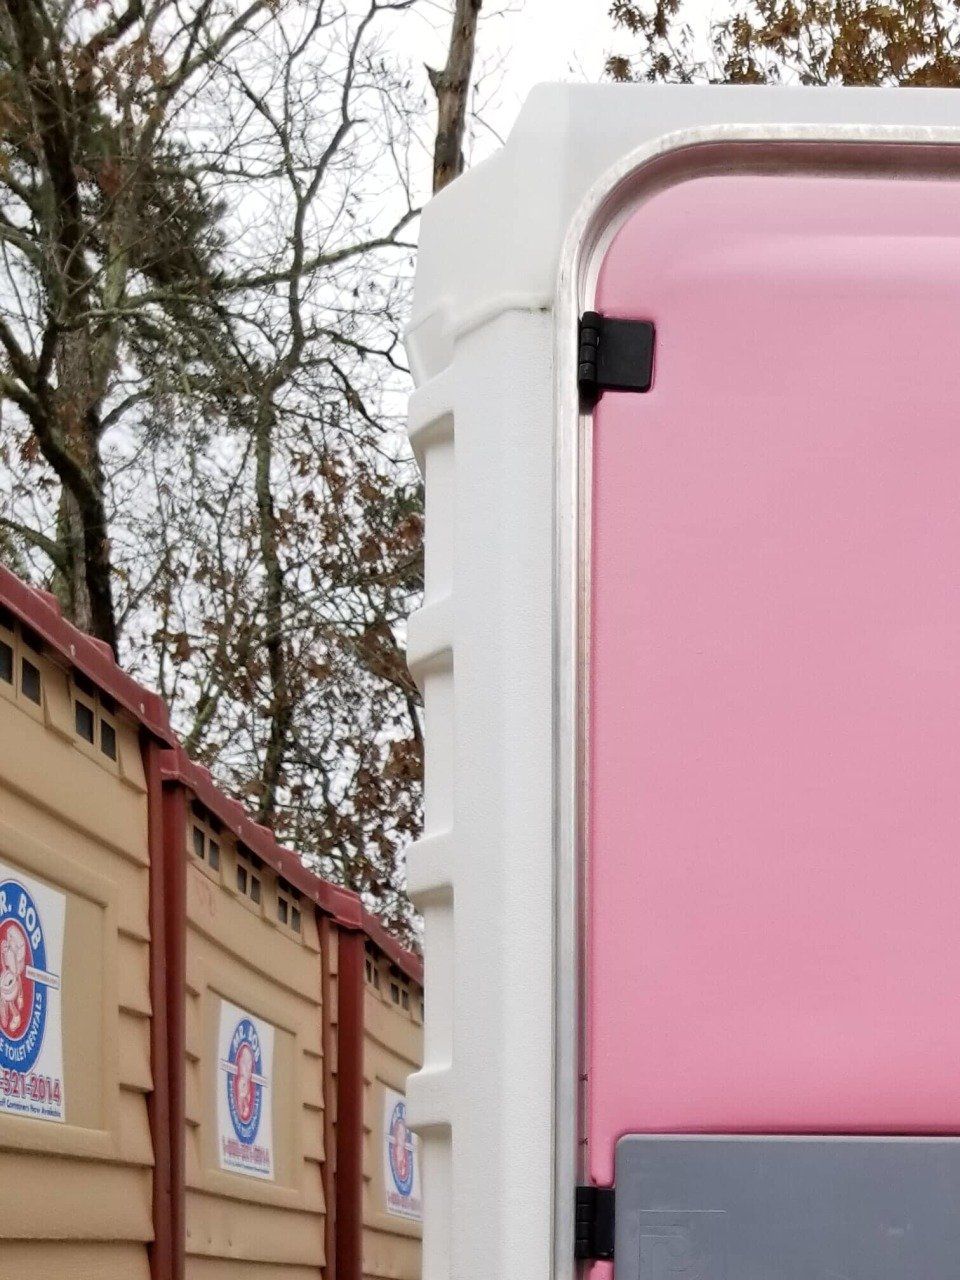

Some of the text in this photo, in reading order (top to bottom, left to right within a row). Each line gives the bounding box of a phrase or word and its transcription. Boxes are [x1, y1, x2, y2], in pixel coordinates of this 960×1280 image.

[18, 893, 42, 950] BOB
[5, 992, 42, 1062] TOILET RENTALS
